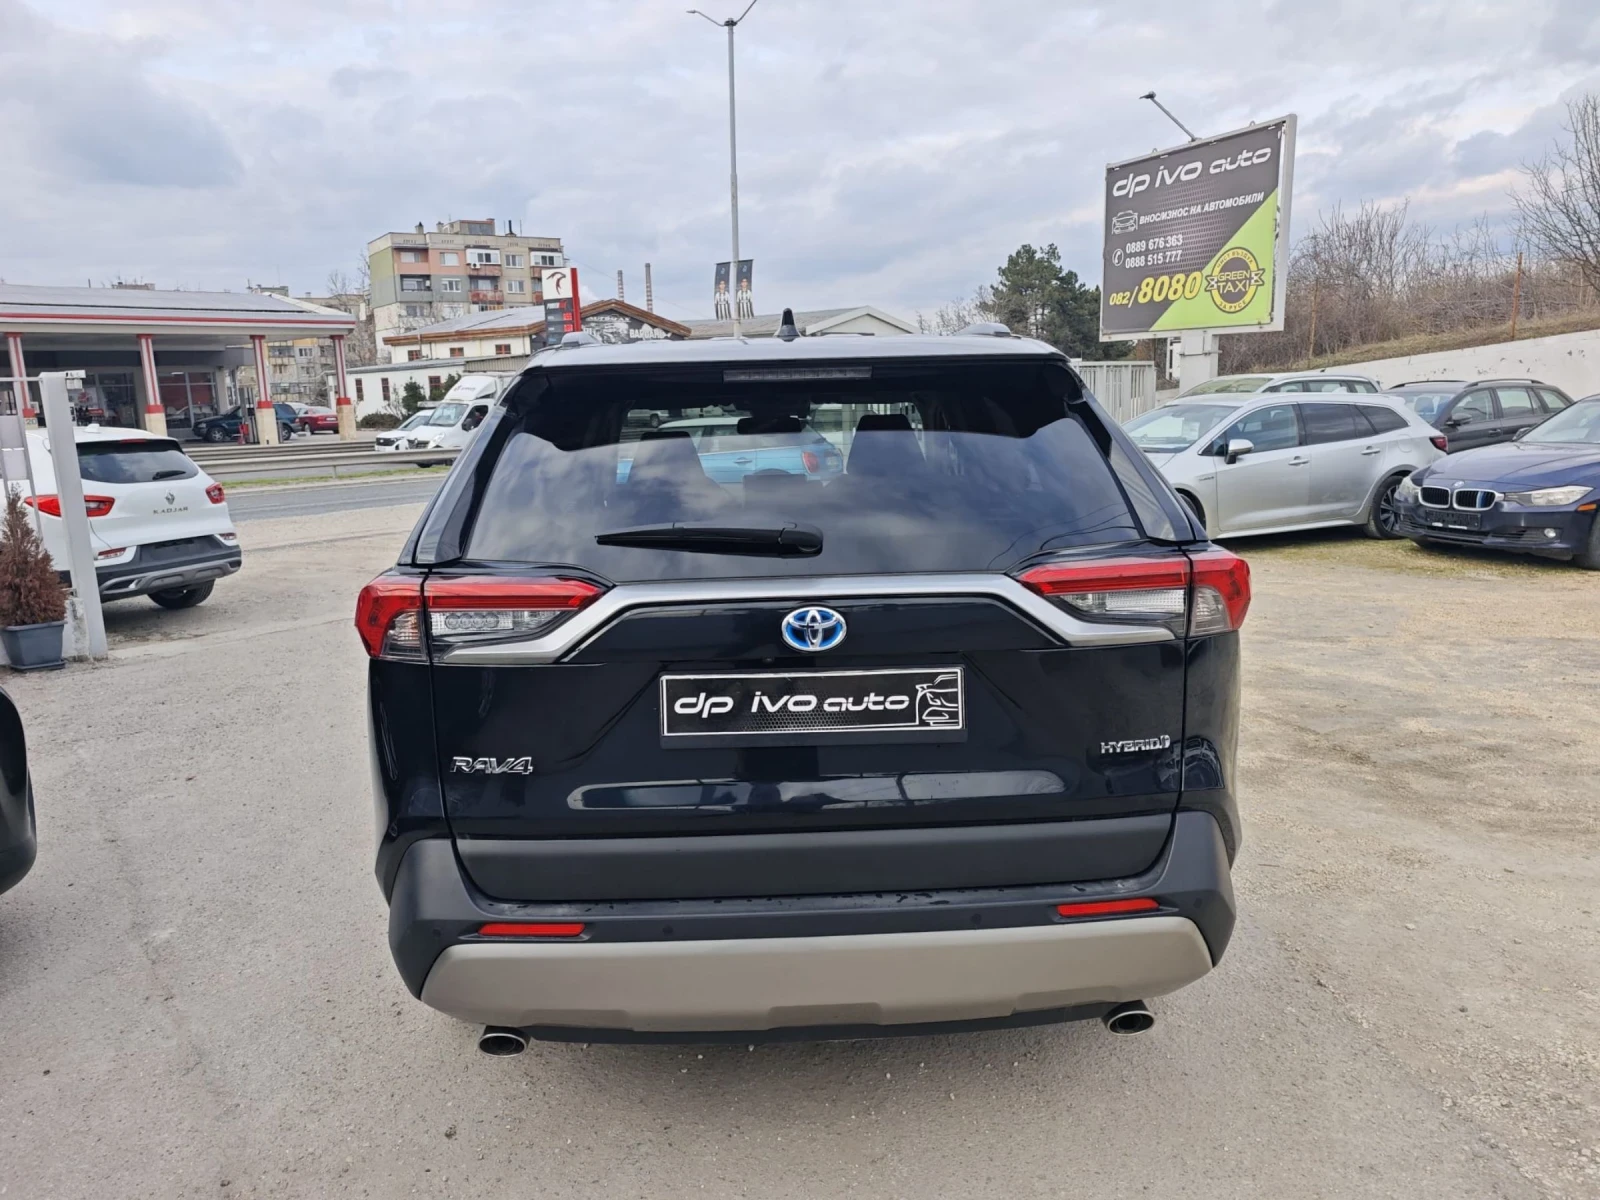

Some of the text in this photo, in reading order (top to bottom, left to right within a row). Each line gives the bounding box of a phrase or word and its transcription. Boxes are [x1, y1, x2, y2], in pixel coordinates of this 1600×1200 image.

[1112, 147, 1272, 198] dp ivo auto
[1190, 203, 1202, 214] НА
[1203, 191, 1265, 213] АВТОМОБИЛИ
[1126, 234, 1183, 254] 0889 676 363
[1125, 250, 1182, 269] 0888 515 777
[1218, 270, 1250, 282] GREEN
[1218, 280, 1249, 294] TAXI
[153, 506, 188, 515] KADJAR
[674, 691, 910, 718] dp ivo auto
[1100, 737, 1162, 754] HYBRID
[450, 756, 533, 775] RAV4
